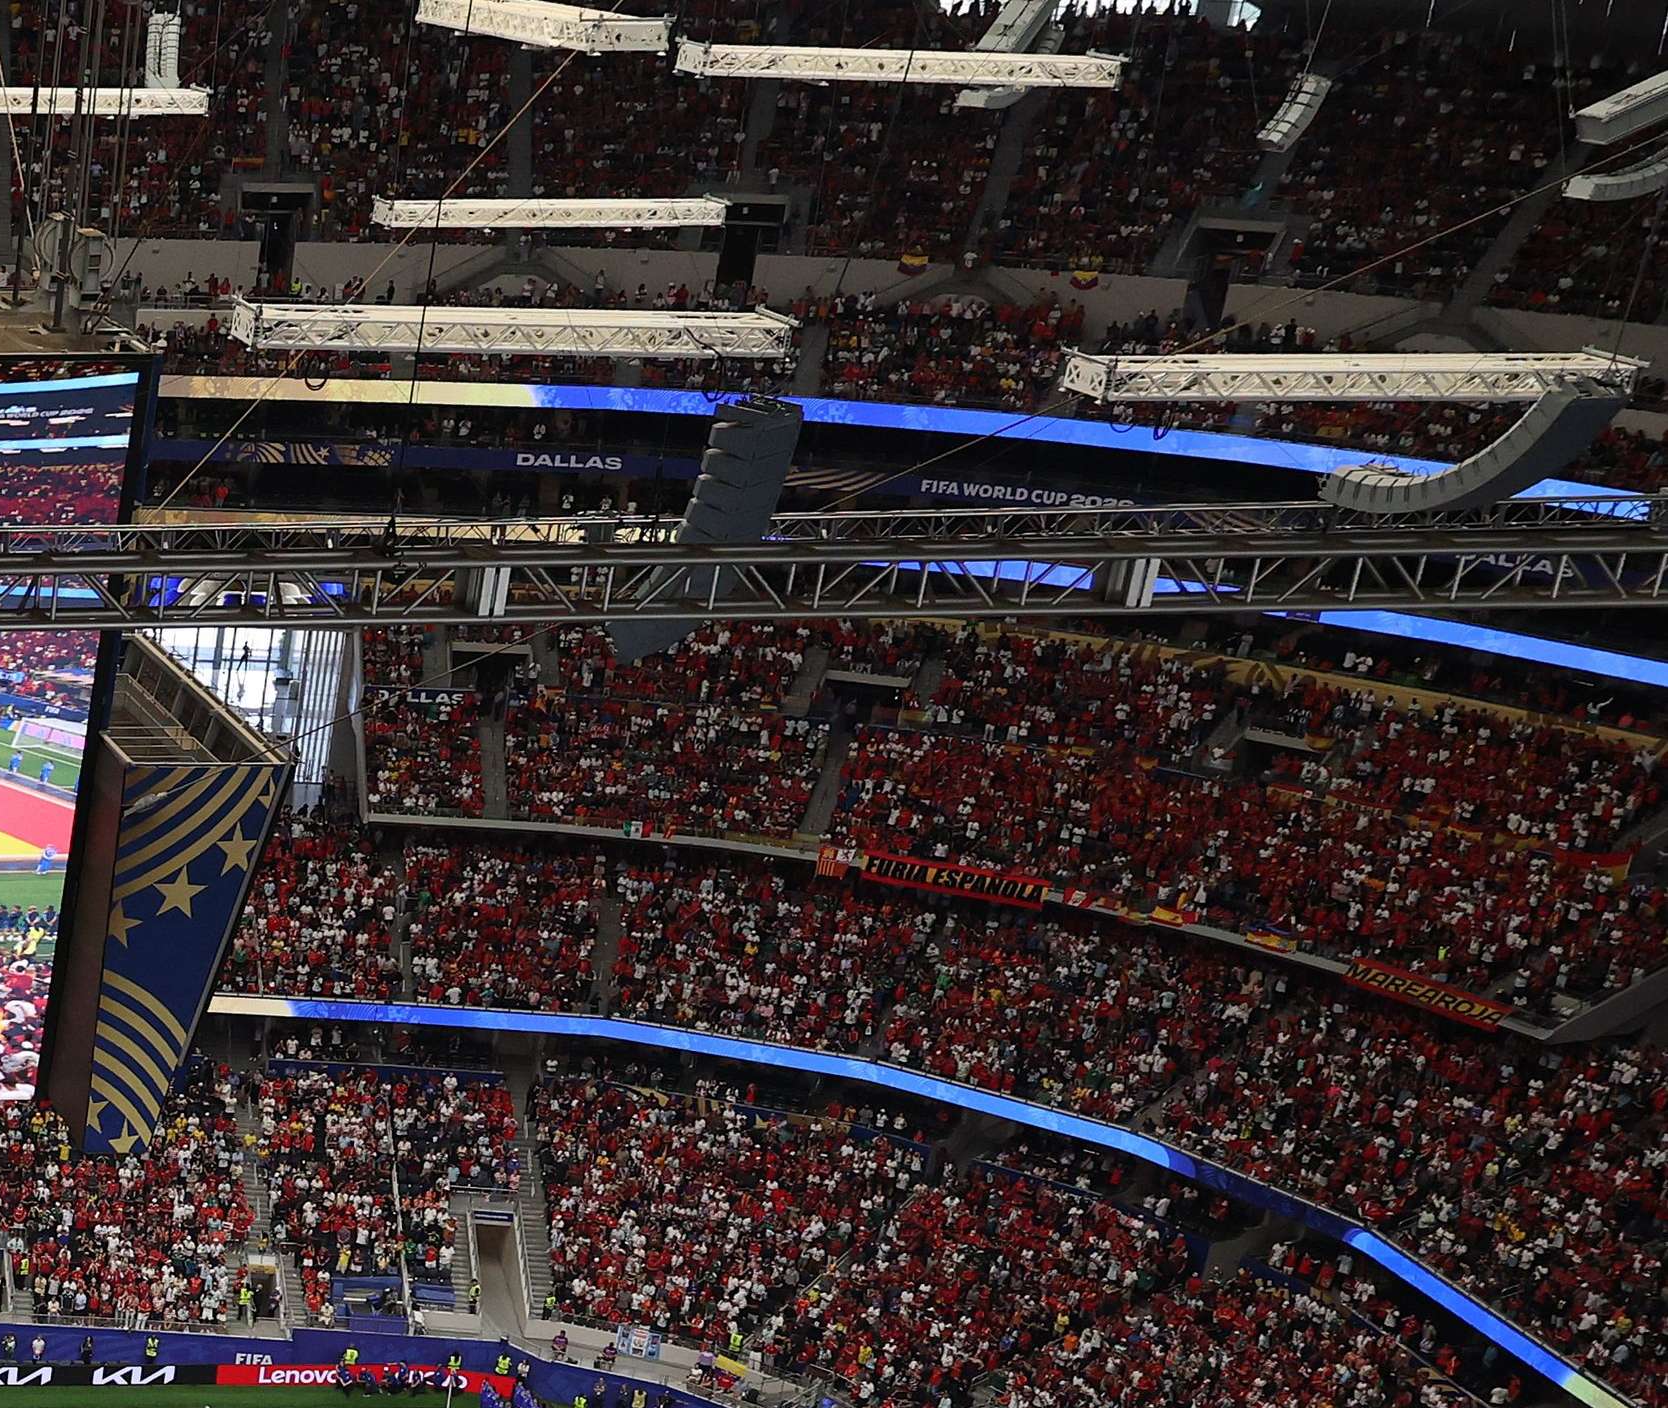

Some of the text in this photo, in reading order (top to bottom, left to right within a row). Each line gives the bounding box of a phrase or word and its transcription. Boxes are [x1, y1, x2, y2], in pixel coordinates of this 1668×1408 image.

[516, 453, 623, 470] DALLAS
[920, 479, 959, 496] FIFA
[963, 482, 1030, 503] WORLD
[1031, 489, 1068, 507] CUP
[235, 1352, 273, 1366] FIFA
[92, 1365, 176, 1386] KIA
